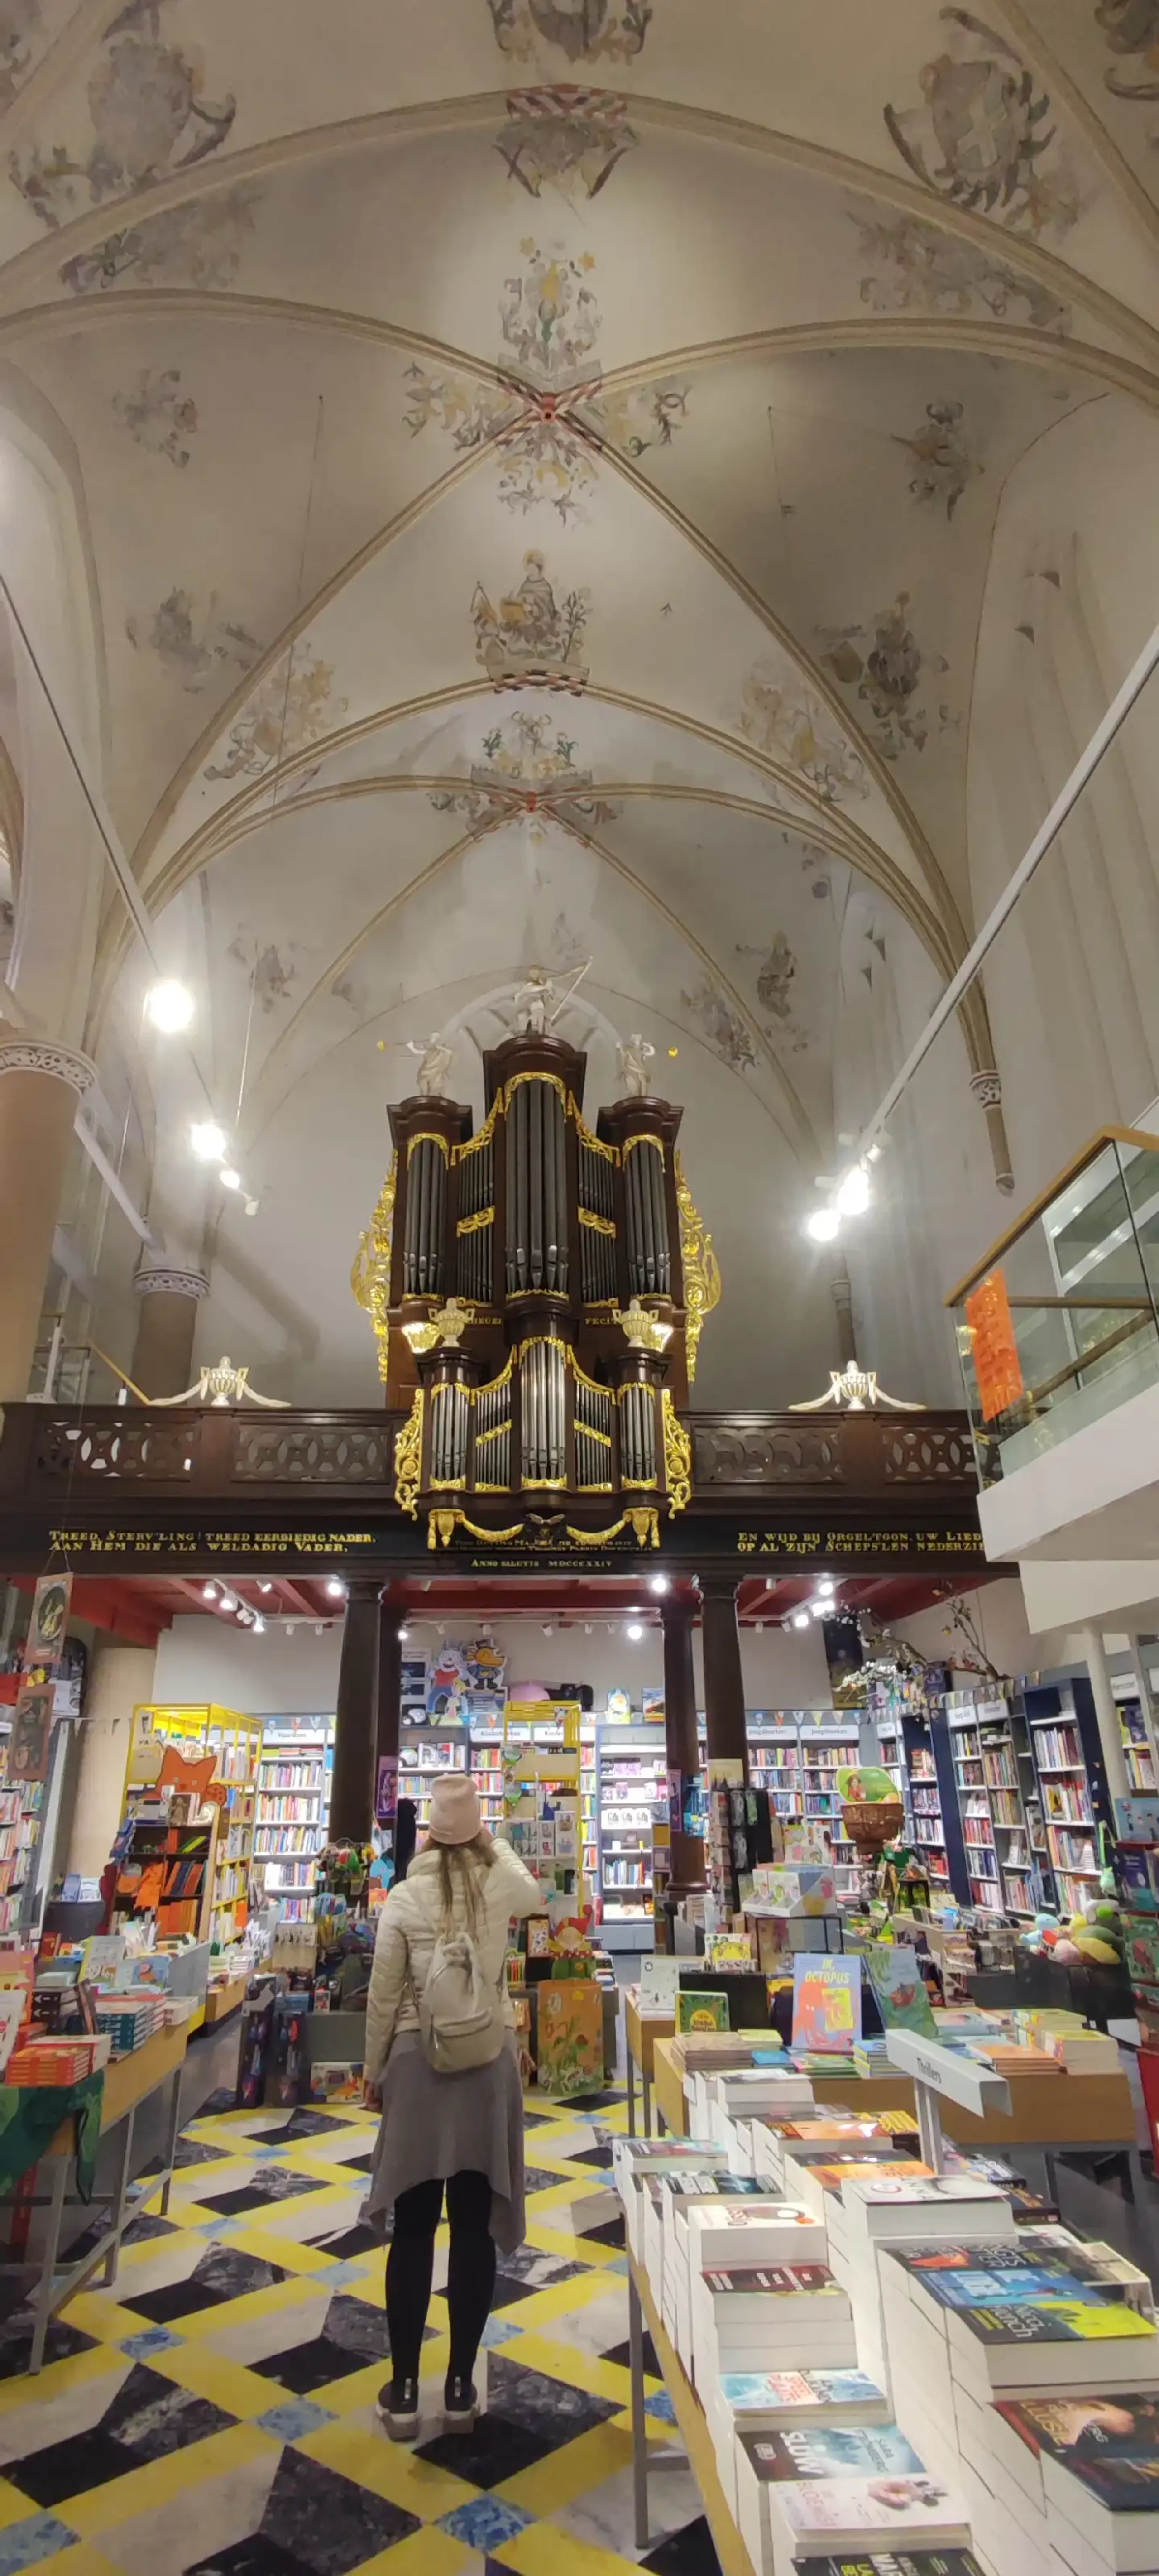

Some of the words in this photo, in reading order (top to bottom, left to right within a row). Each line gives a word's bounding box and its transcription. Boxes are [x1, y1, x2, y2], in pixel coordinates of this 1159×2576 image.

[738, 1532, 757, 1541] EN
[764, 1533, 798, 1543] WIJD
[803, 1533, 821, 1543] BIJ
[49, 1541, 83, 1551] AAN
[90, 1540, 127, 1551] HEM
[134, 1542, 162, 1551] DIE
[168, 1543, 198, 1551] ALS
[206, 1543, 287, 1552] WELDADIG
[737, 1542, 756, 1552] OP
[759, 1542, 780, 1552] AL
[785, 1542, 817, 1554] ZIJN
[805, 1971, 851, 1984] OCTOPUS
[917, 2057, 942, 2084] Thrillers
